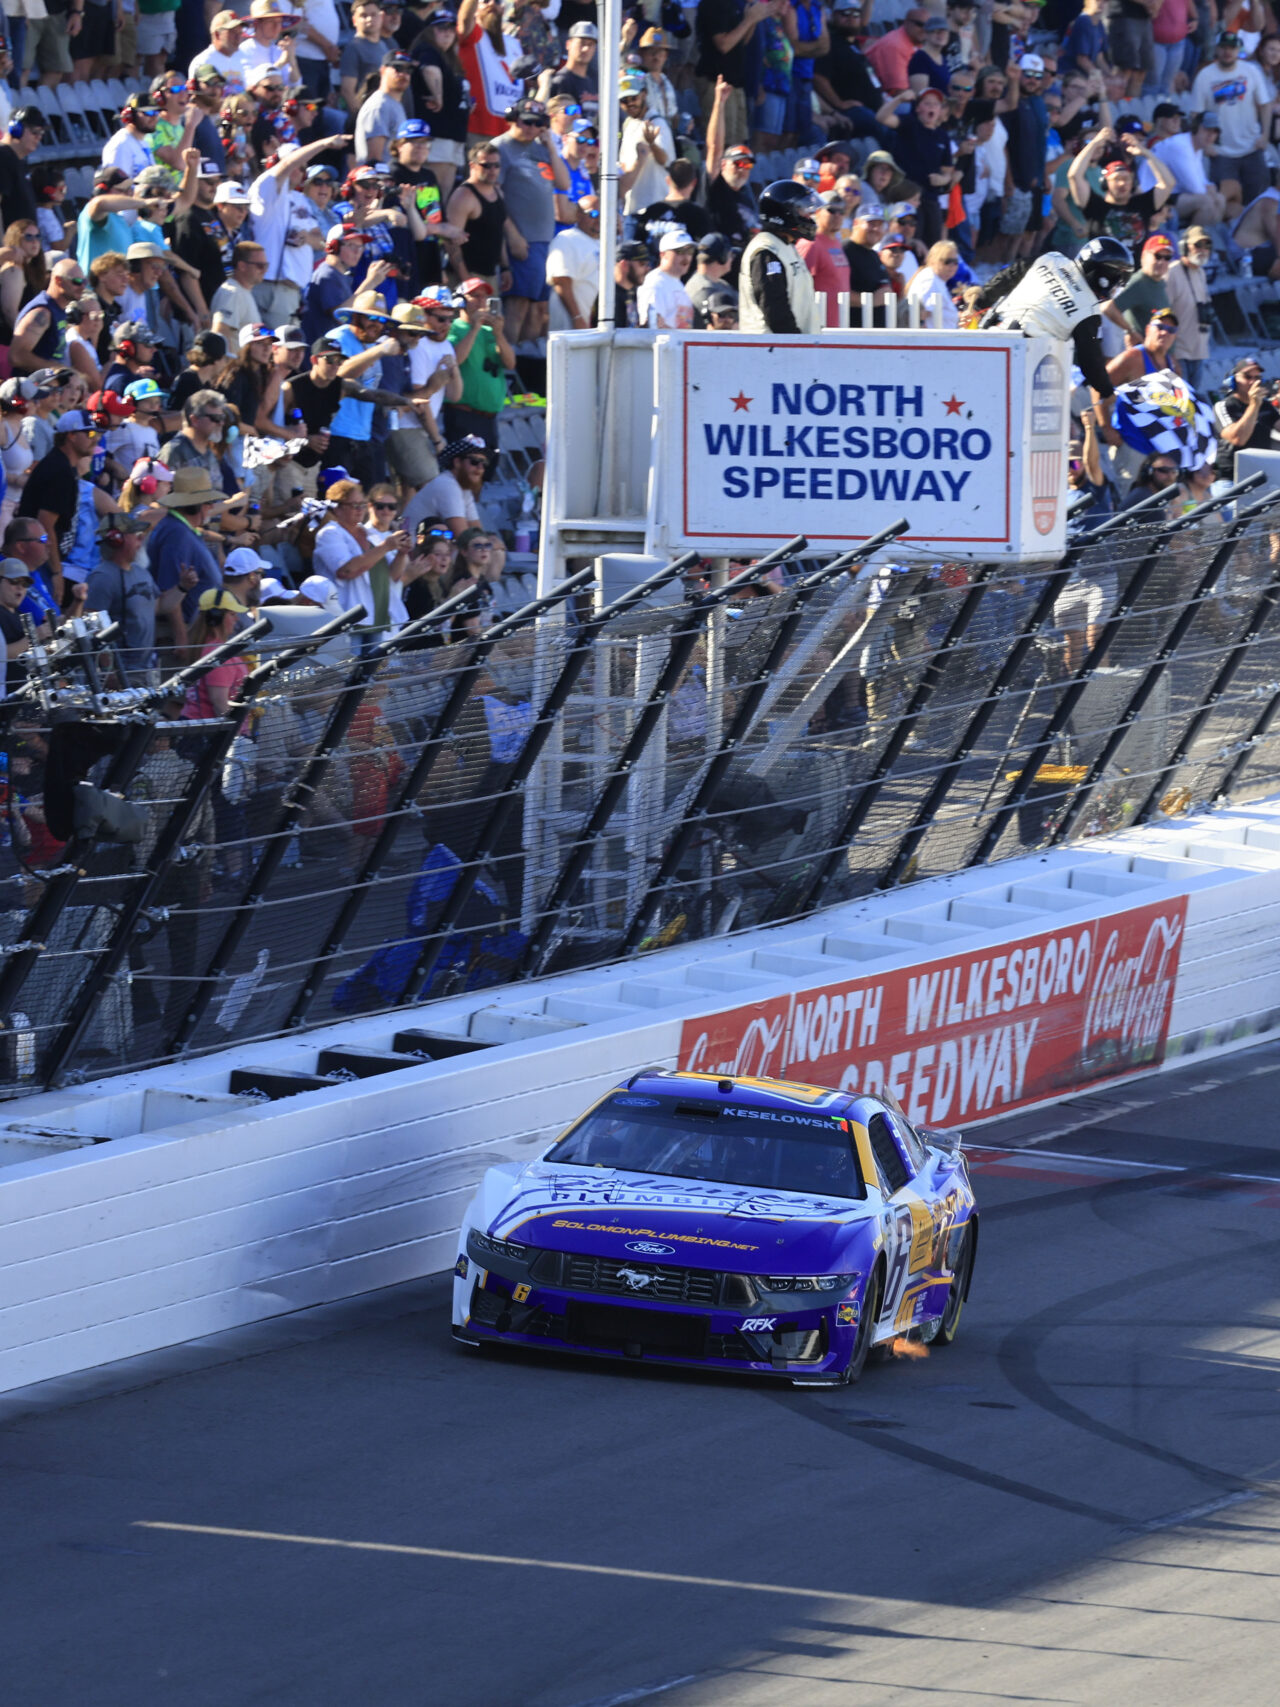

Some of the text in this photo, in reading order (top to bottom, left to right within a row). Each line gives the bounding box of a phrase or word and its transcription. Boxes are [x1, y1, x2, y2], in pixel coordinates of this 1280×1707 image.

[1035, 265, 1079, 318] OFFICIAL
[771, 383, 924, 418] NORTH
[704, 423, 992, 461] WILKESBORO
[722, 466, 972, 502] SPEEDWAY
[788, 985, 884, 1065] NORTH
[905, 928, 1092, 1036] WILKESBORO
[723, 1107, 842, 1132] KESELOWSKI
[632, 1242, 667, 1255] Ford
[740, 1317, 777, 1332] RFK
